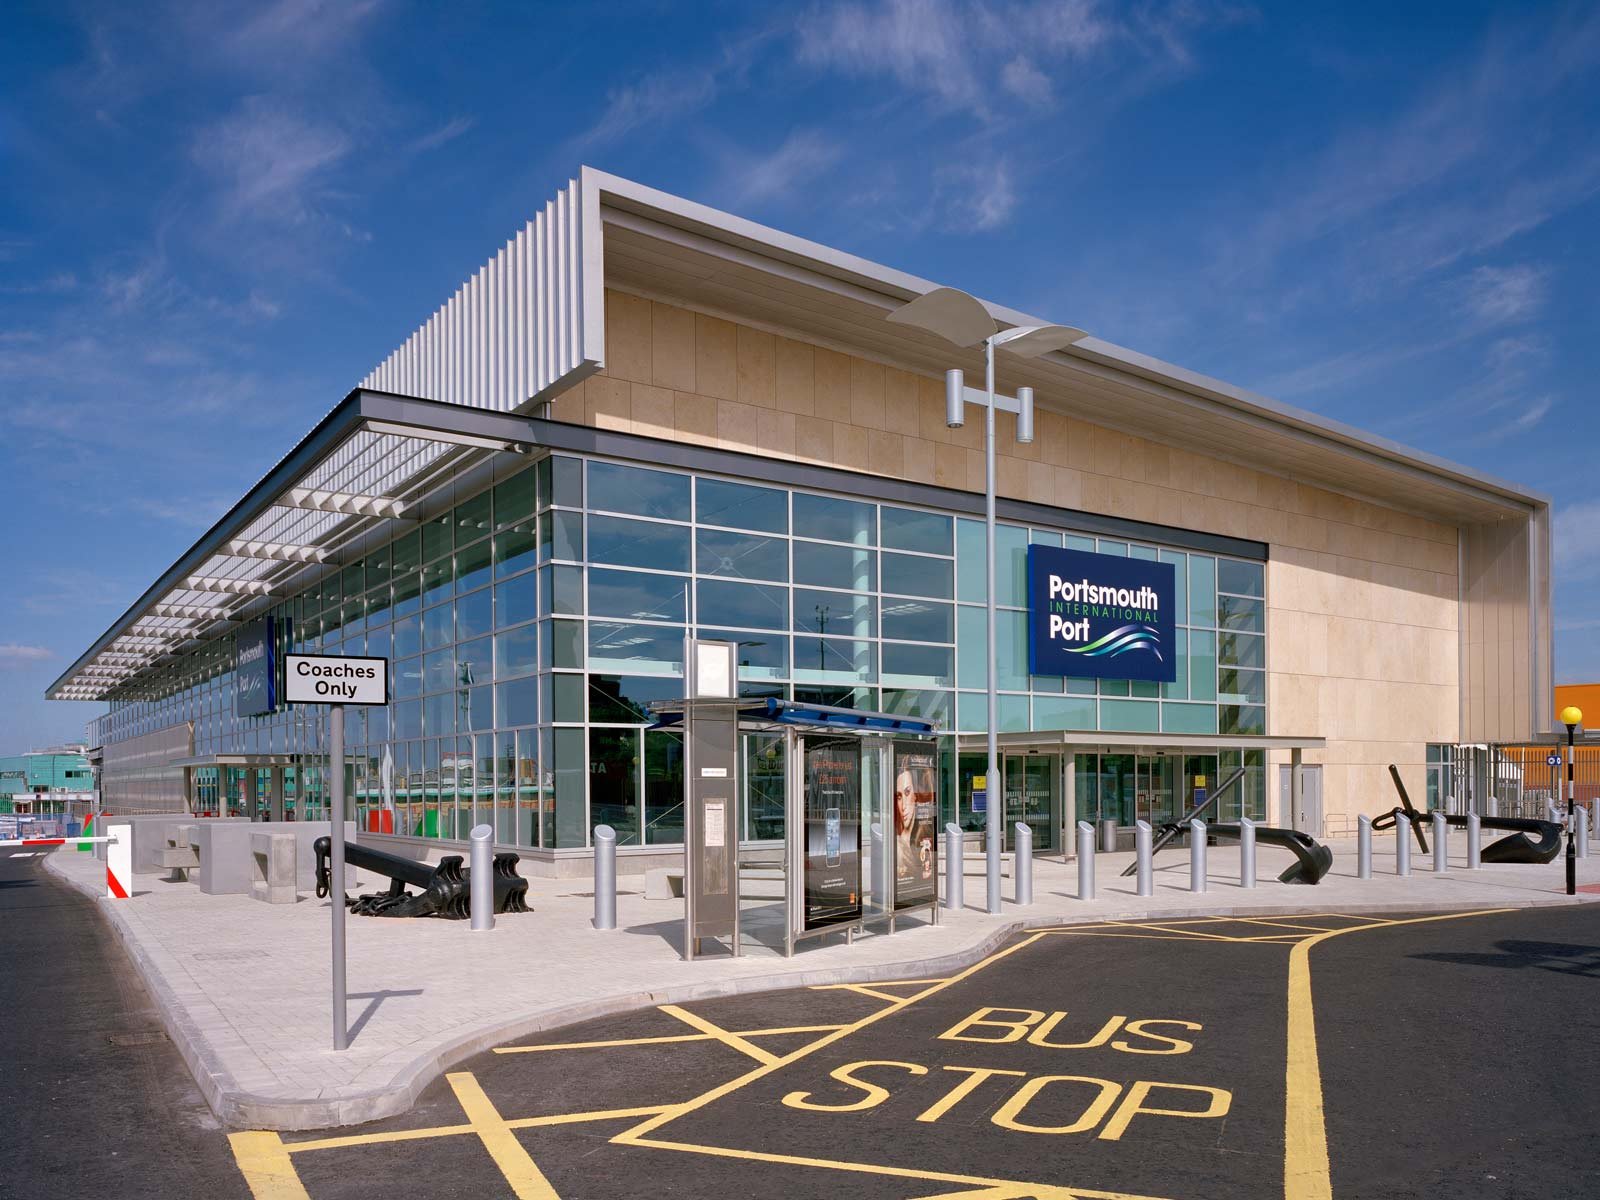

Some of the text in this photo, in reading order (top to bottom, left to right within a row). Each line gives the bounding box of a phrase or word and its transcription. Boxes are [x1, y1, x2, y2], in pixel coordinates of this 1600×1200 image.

[1049, 574, 1158, 611] Portsmouth
[1049, 601, 1158, 623] INTERNATIONAL
[1050, 614, 1090, 642] Port
[296, 661, 375, 678] Coaches
[315, 680, 357, 698] Only
[937, 1007, 1203, 1055] BUS
[781, 1060, 1232, 1140] STOP
